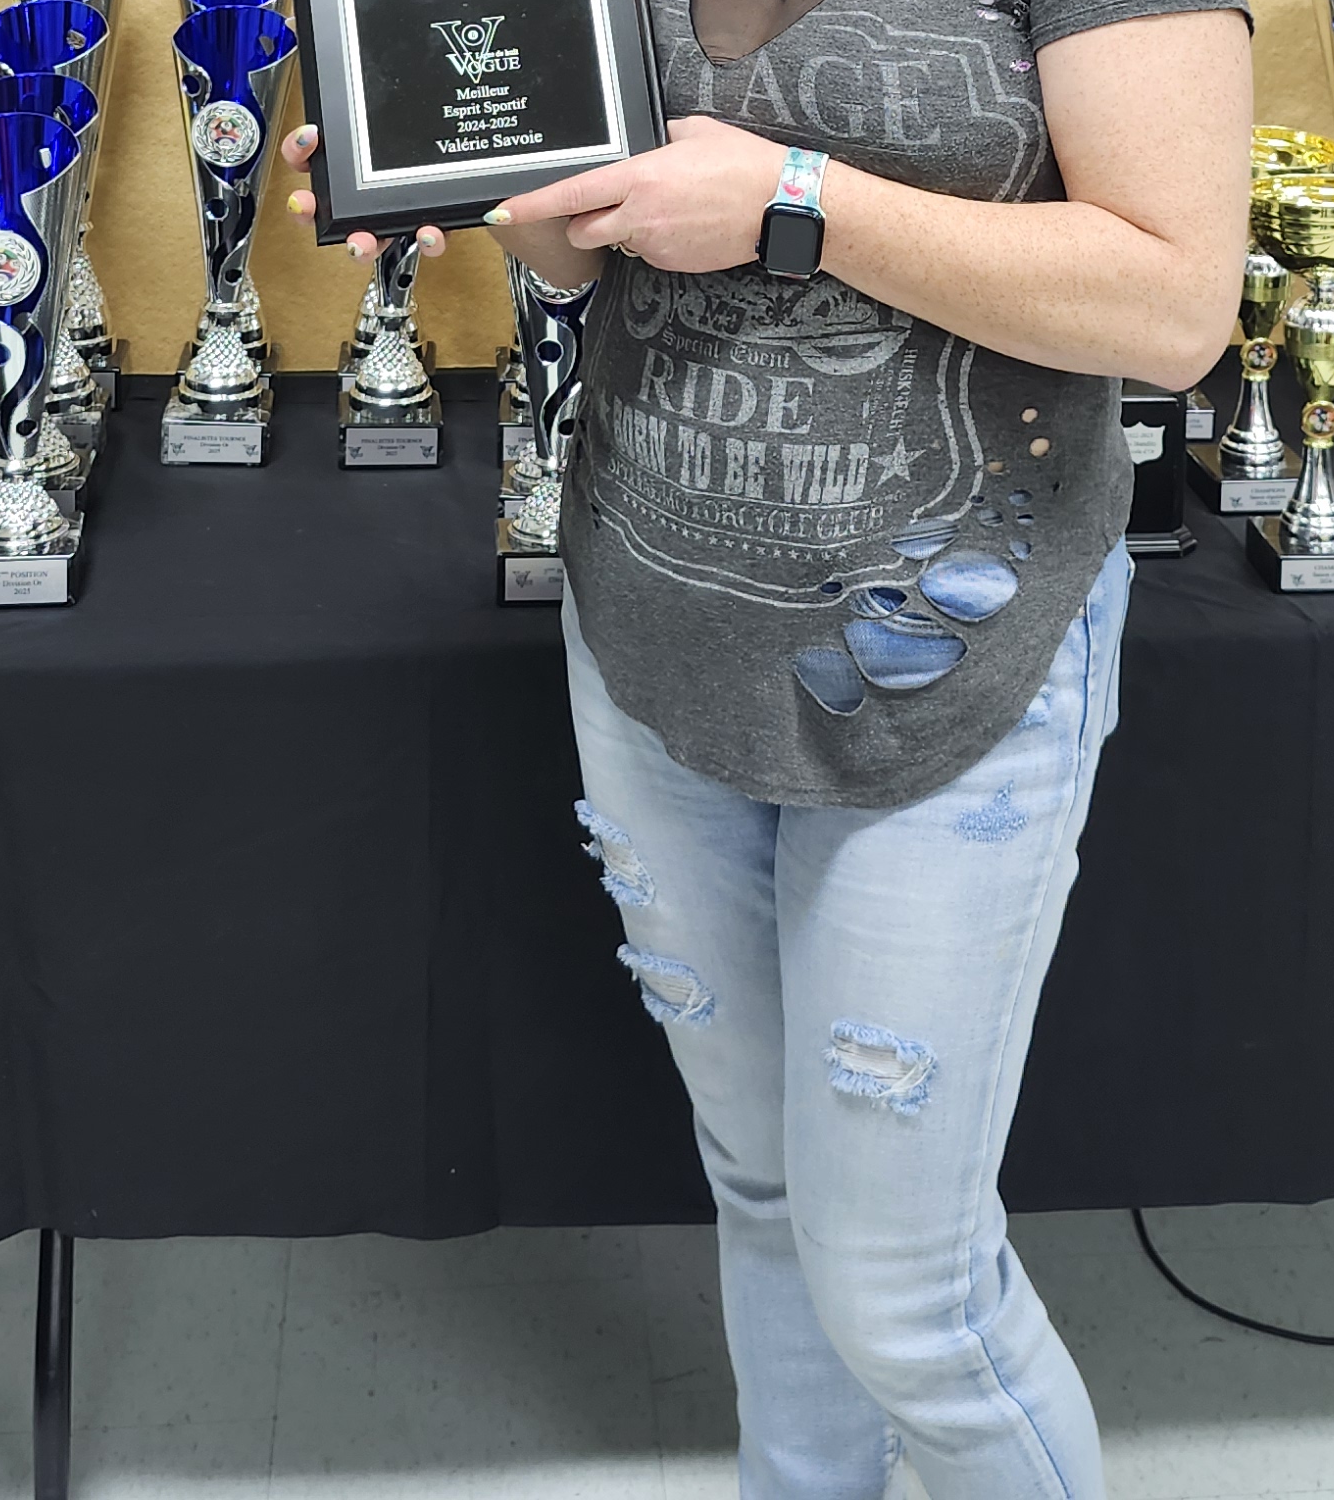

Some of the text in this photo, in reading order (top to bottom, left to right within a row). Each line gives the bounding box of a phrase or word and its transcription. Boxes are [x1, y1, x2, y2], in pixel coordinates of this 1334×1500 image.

[446, 53, 521, 76] VOGUE
[455, 85, 509, 100] Meilleur
[442, 97, 528, 119] Esprit Sportif
[457, 116, 518, 133] 2024-2025
[436, 130, 543, 153] Valérie Savoie
[661, 329, 790, 368] Special Event
[637, 346, 814, 434] RIDE
[678, 426, 712, 490] TO
[725, 438, 767, 499] BE
[782, 443, 870, 503] WILD
